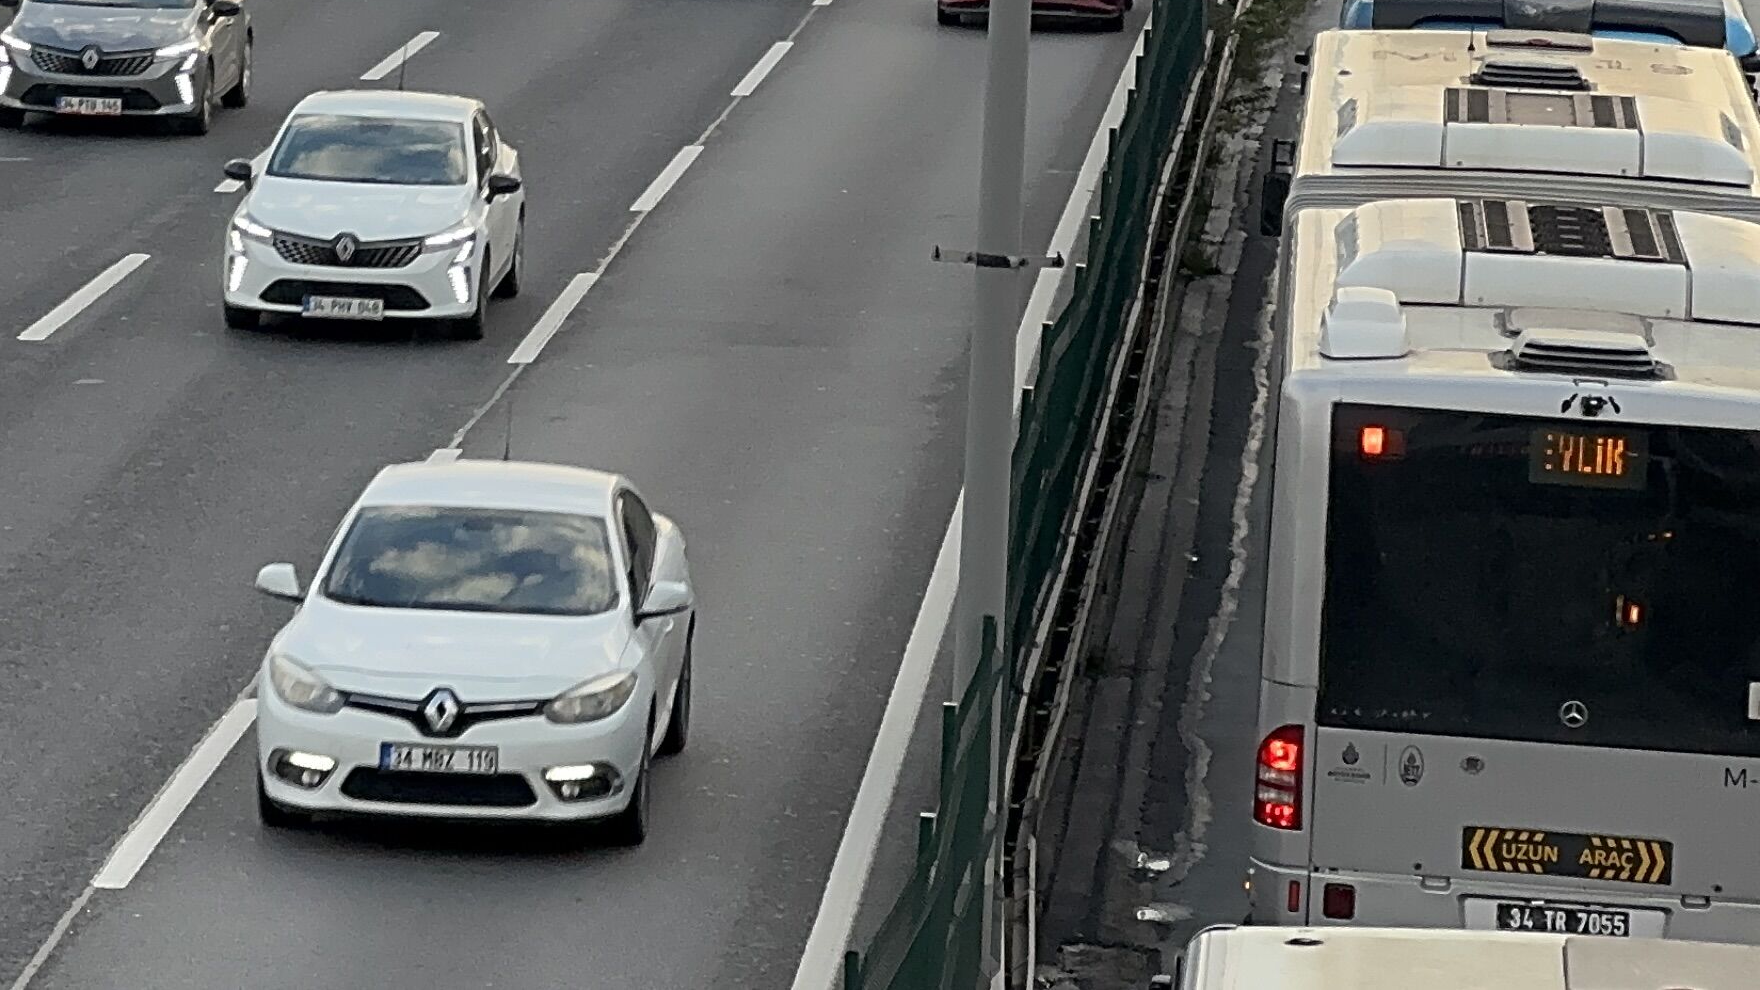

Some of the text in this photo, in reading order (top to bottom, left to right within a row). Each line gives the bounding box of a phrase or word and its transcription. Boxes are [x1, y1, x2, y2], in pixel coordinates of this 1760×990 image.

[393, 750, 412, 768] 34
[1502, 843, 1634, 873] UZUN ARAÇ
[1509, 908, 1625, 936] 34 TR 7055
